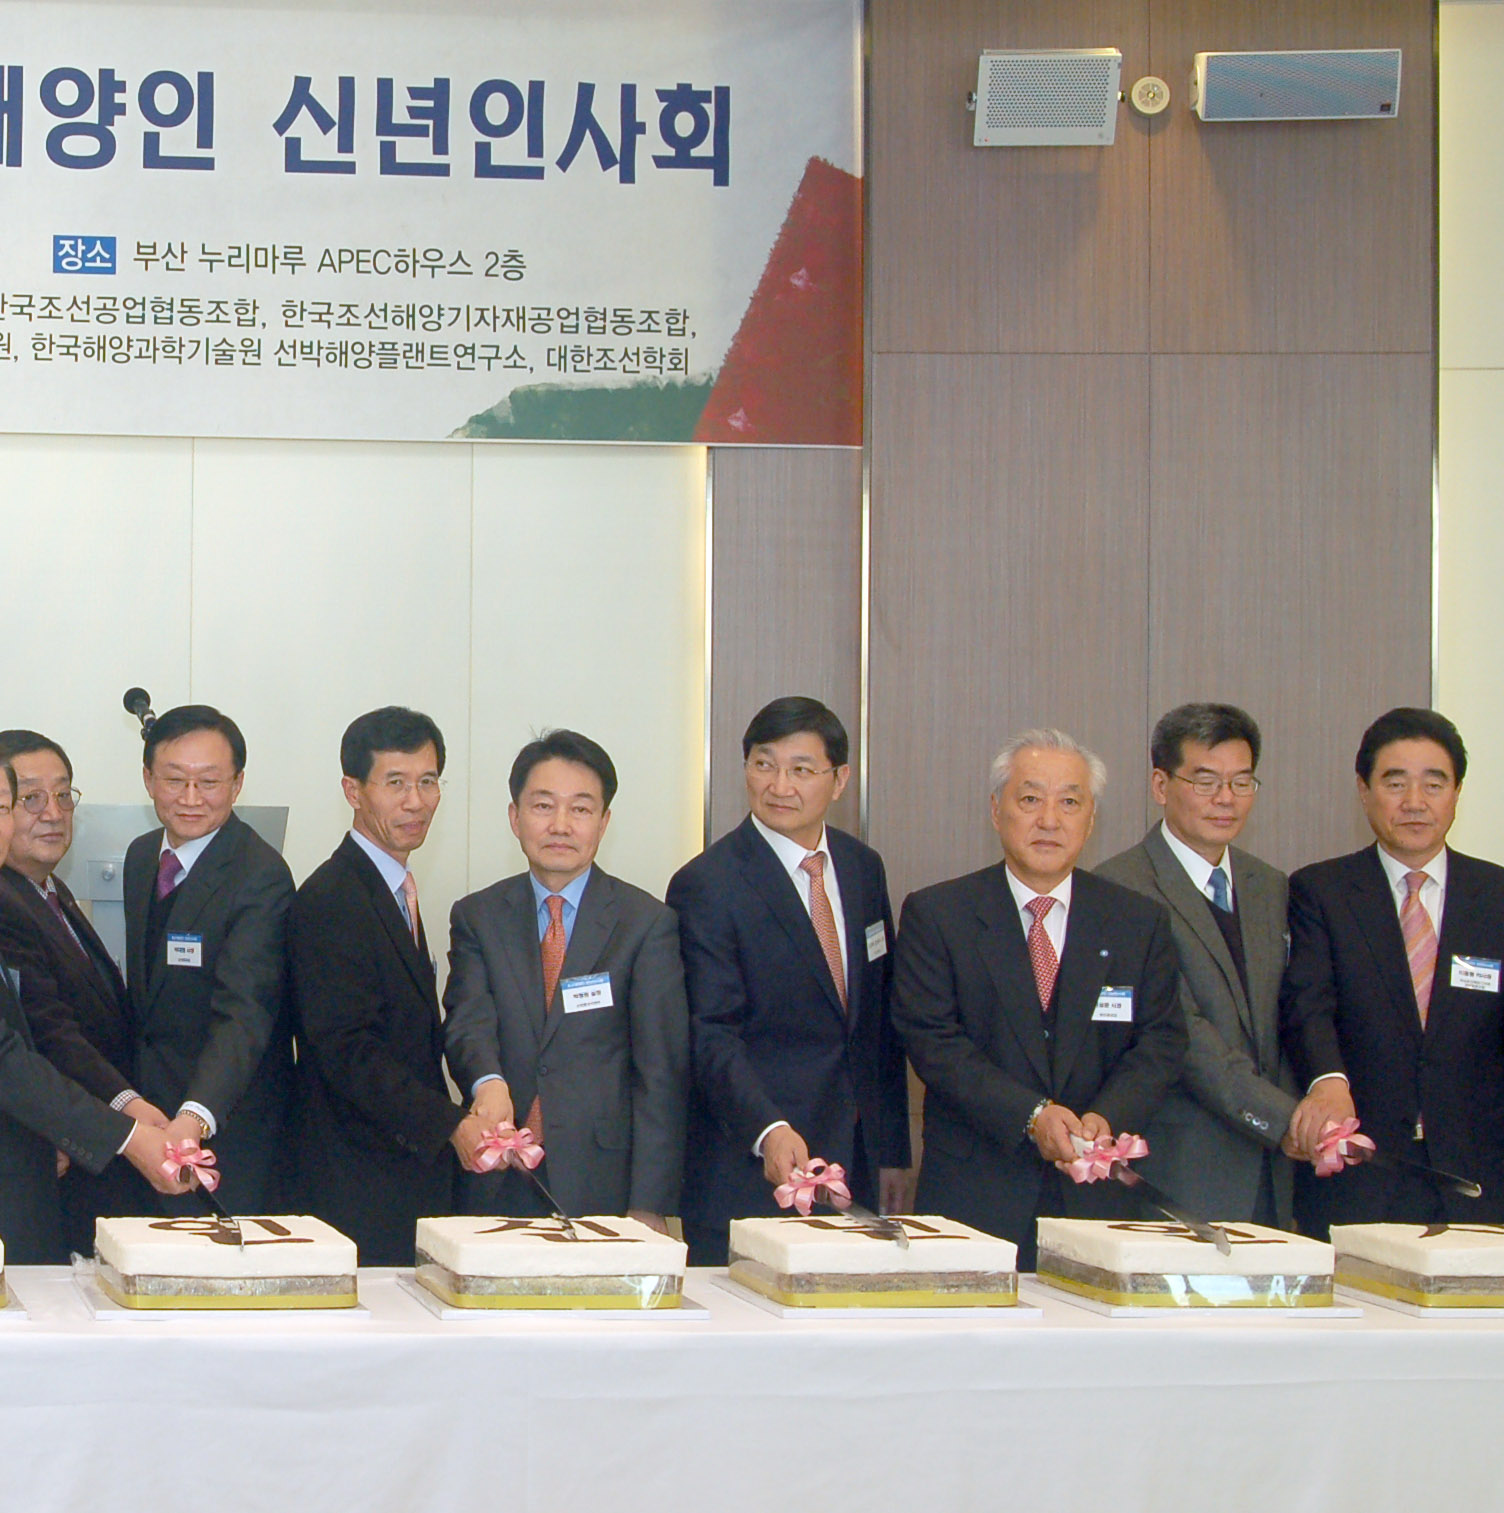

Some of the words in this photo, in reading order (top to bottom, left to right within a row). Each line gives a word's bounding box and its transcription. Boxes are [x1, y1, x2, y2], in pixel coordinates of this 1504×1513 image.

[273, 76, 730, 187] 신년인사회
[58, 239, 112, 270] 장소
[134, 241, 187, 271] 부산
[199, 243, 306, 274] 누리마루
[318, 248, 473, 278] APEC하우스
[485, 250, 526, 281] 2층
[281, 300, 696, 342] 한국조선해양기자재공업협동조합,
[32, 333, 261, 365] 한국해양과학기술원
[274, 339, 533, 373] 선박해양플랜트연구소,
[547, 345, 688, 377] 대한조선학회
